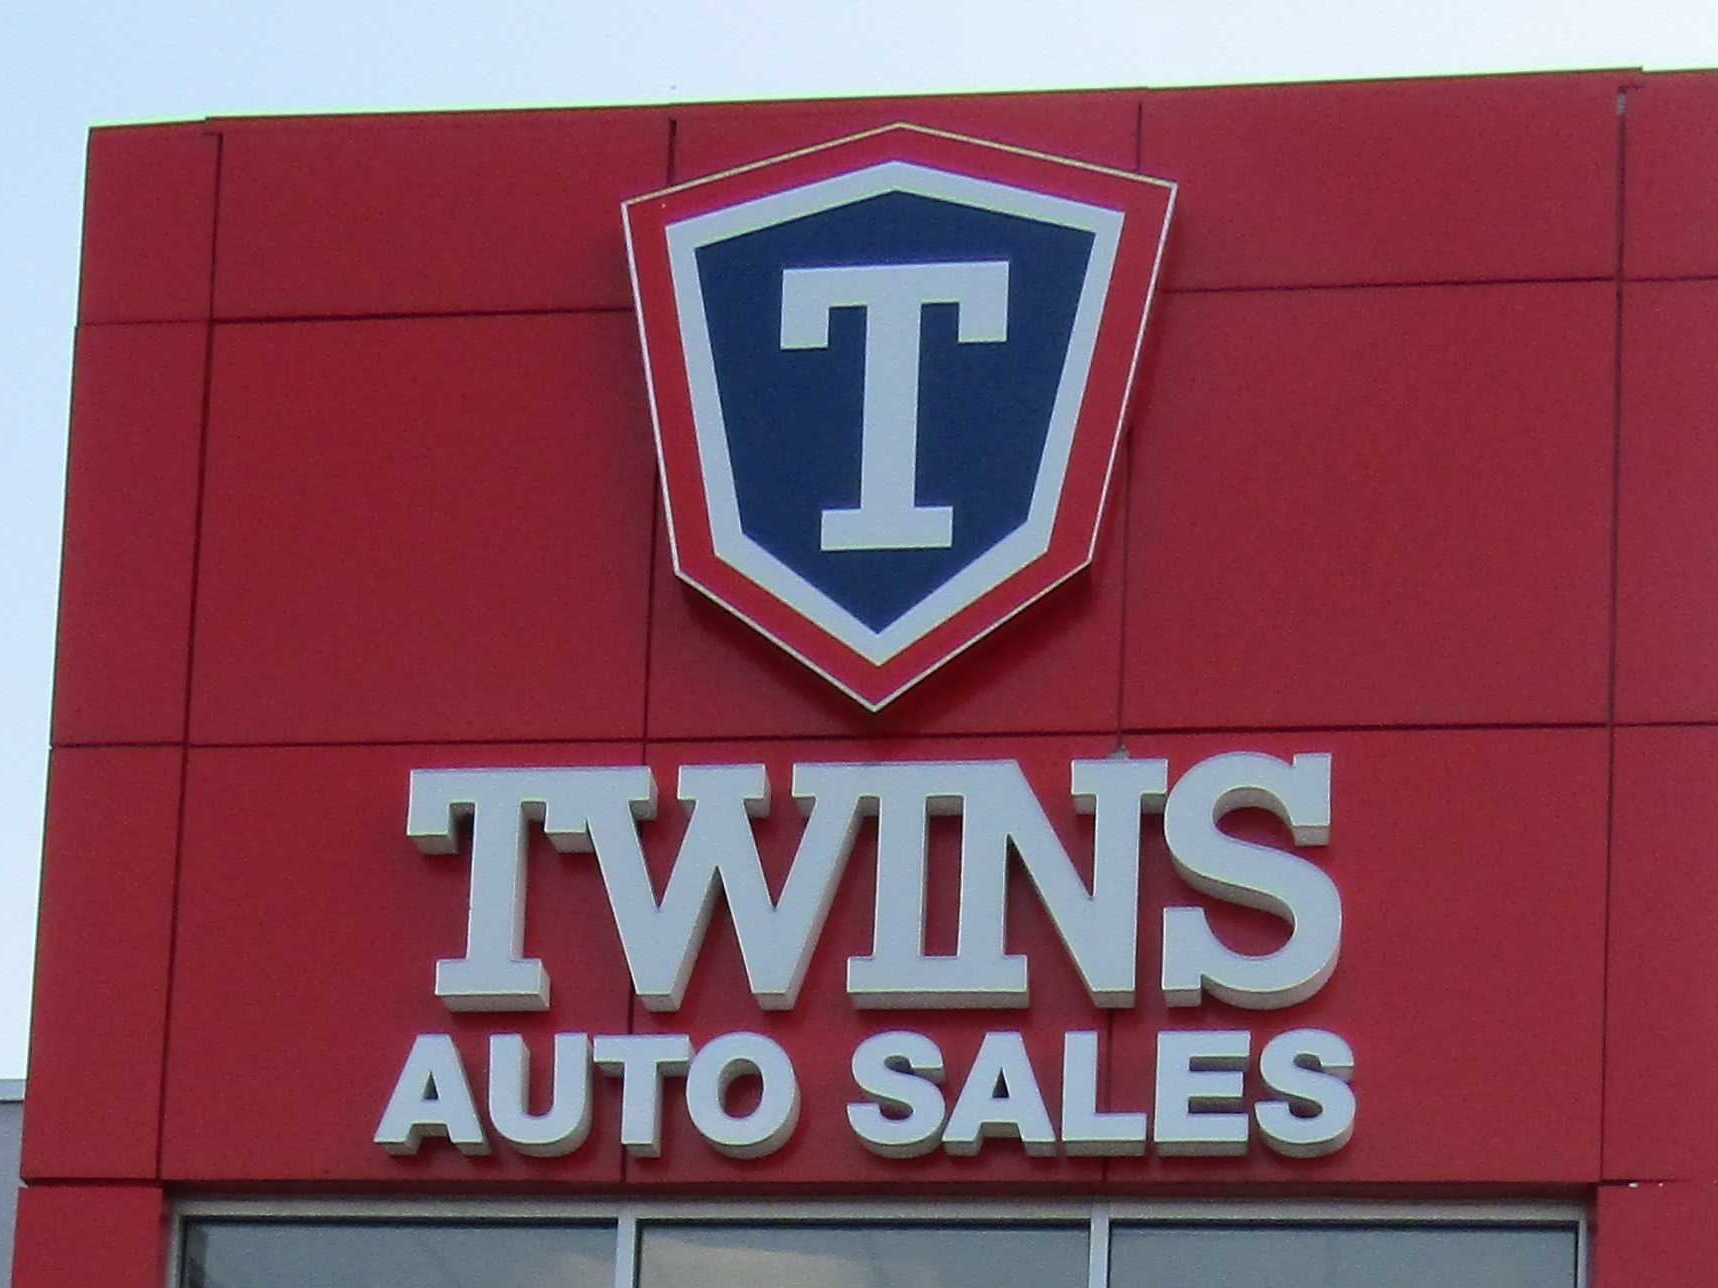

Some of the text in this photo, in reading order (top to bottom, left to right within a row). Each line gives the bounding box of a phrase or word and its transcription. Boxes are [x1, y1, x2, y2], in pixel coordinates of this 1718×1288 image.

[780, 261, 1009, 552] T
[407, 751, 1342, 1012] TWINS
[374, 1029, 1357, 1158] AUTO SALES
